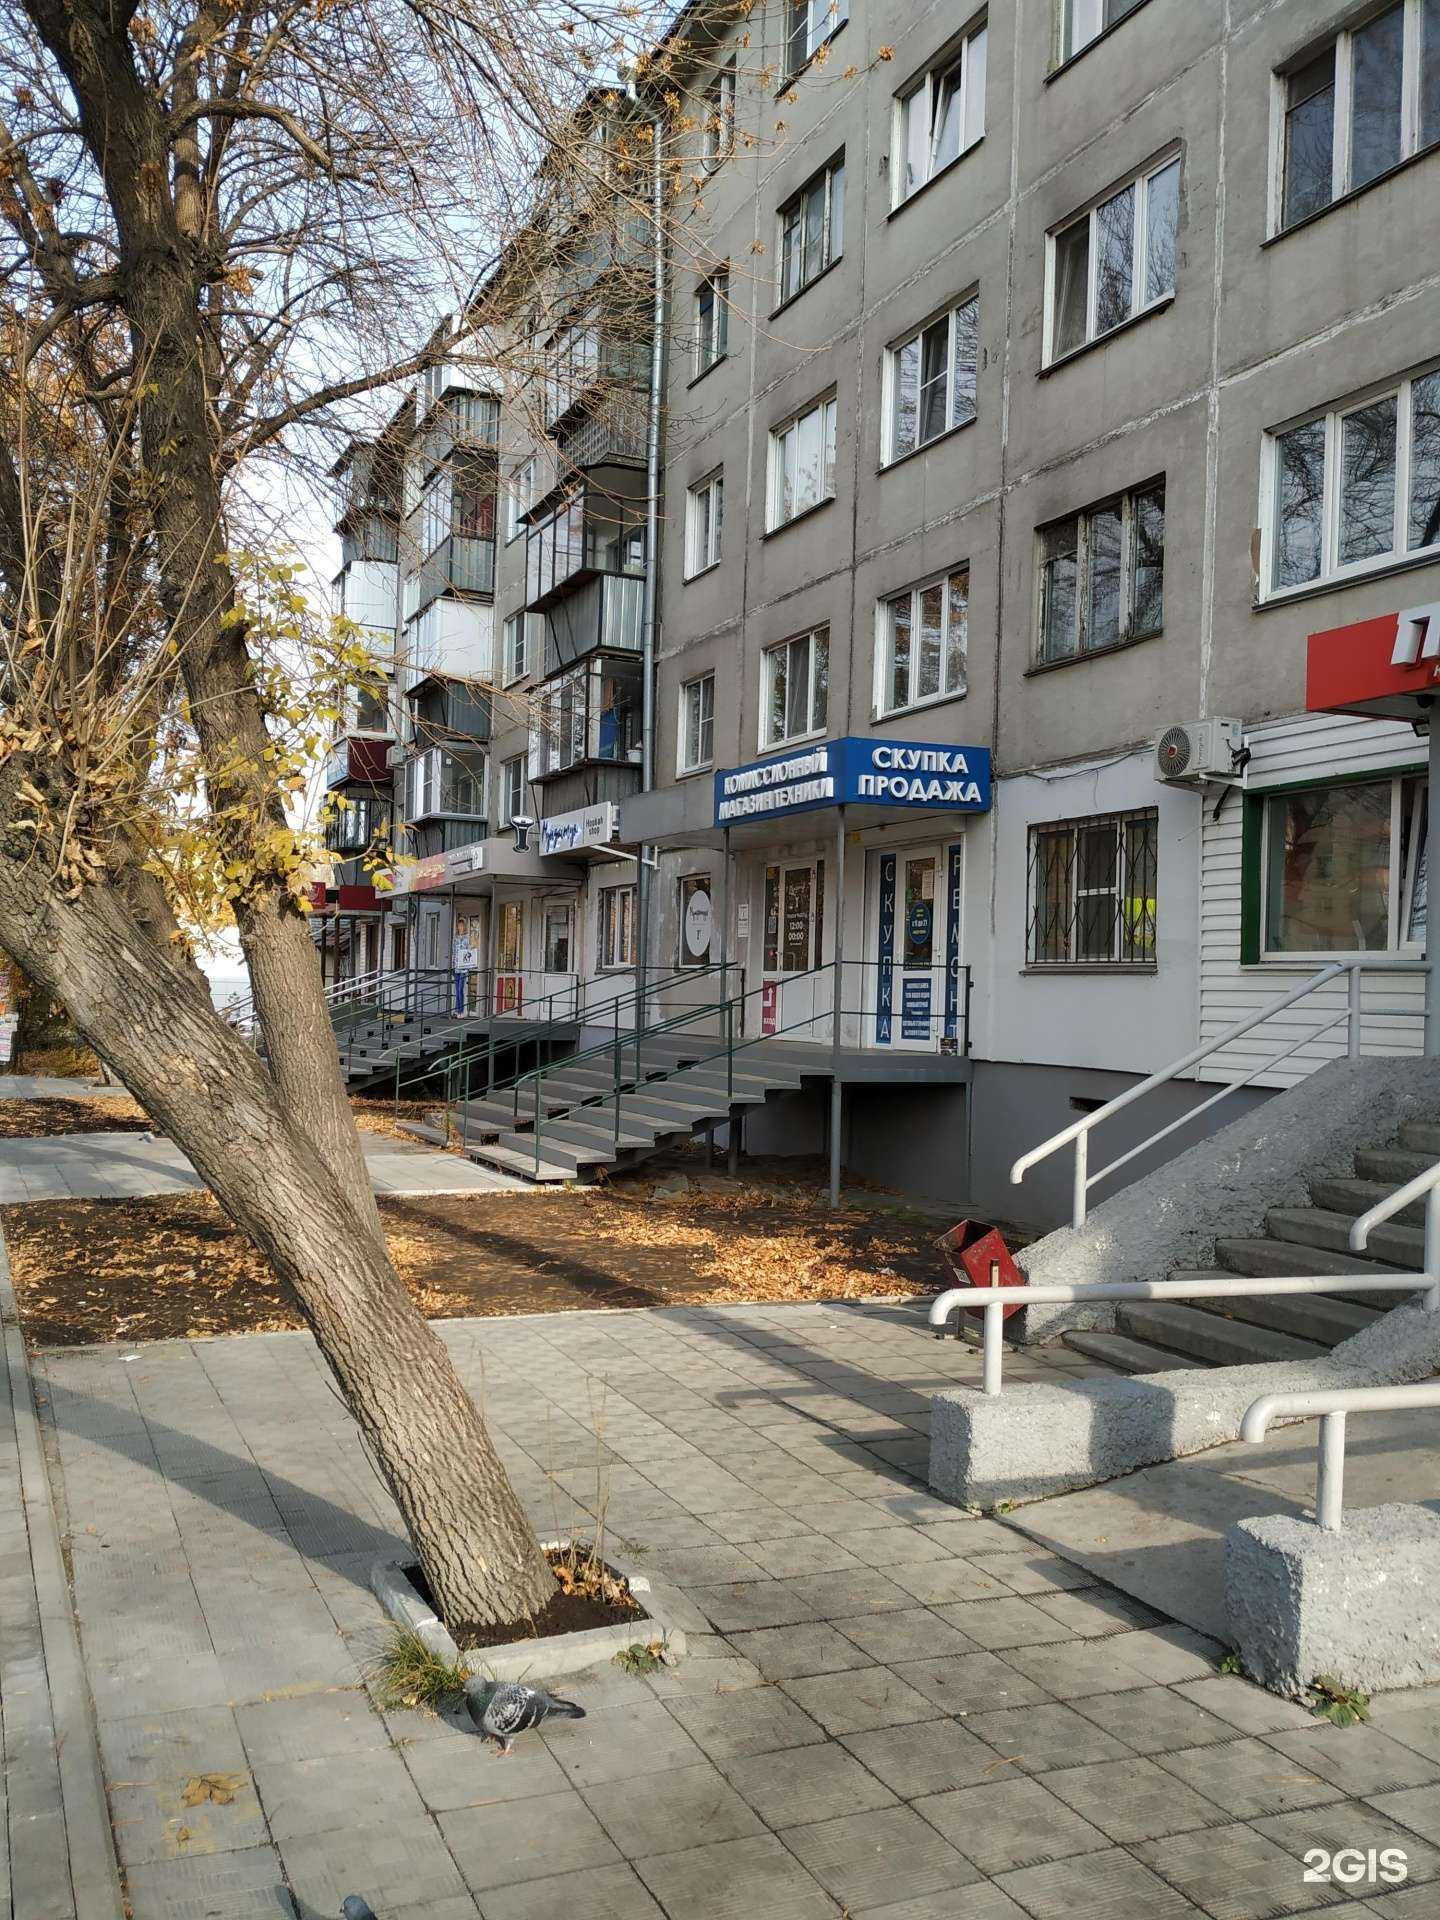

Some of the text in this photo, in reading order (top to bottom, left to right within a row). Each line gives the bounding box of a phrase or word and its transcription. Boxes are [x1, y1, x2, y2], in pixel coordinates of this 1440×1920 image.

[724, 746, 828, 795] КОМИССИОННЫЙ
[871, 746, 969, 774] СКУПКА
[719, 777, 834, 820] МАГАЗИН ТЕХНИКИ
[858, 774, 982, 803] ПРОДАЖА
[880, 861, 894, 1038] СКУПКА
